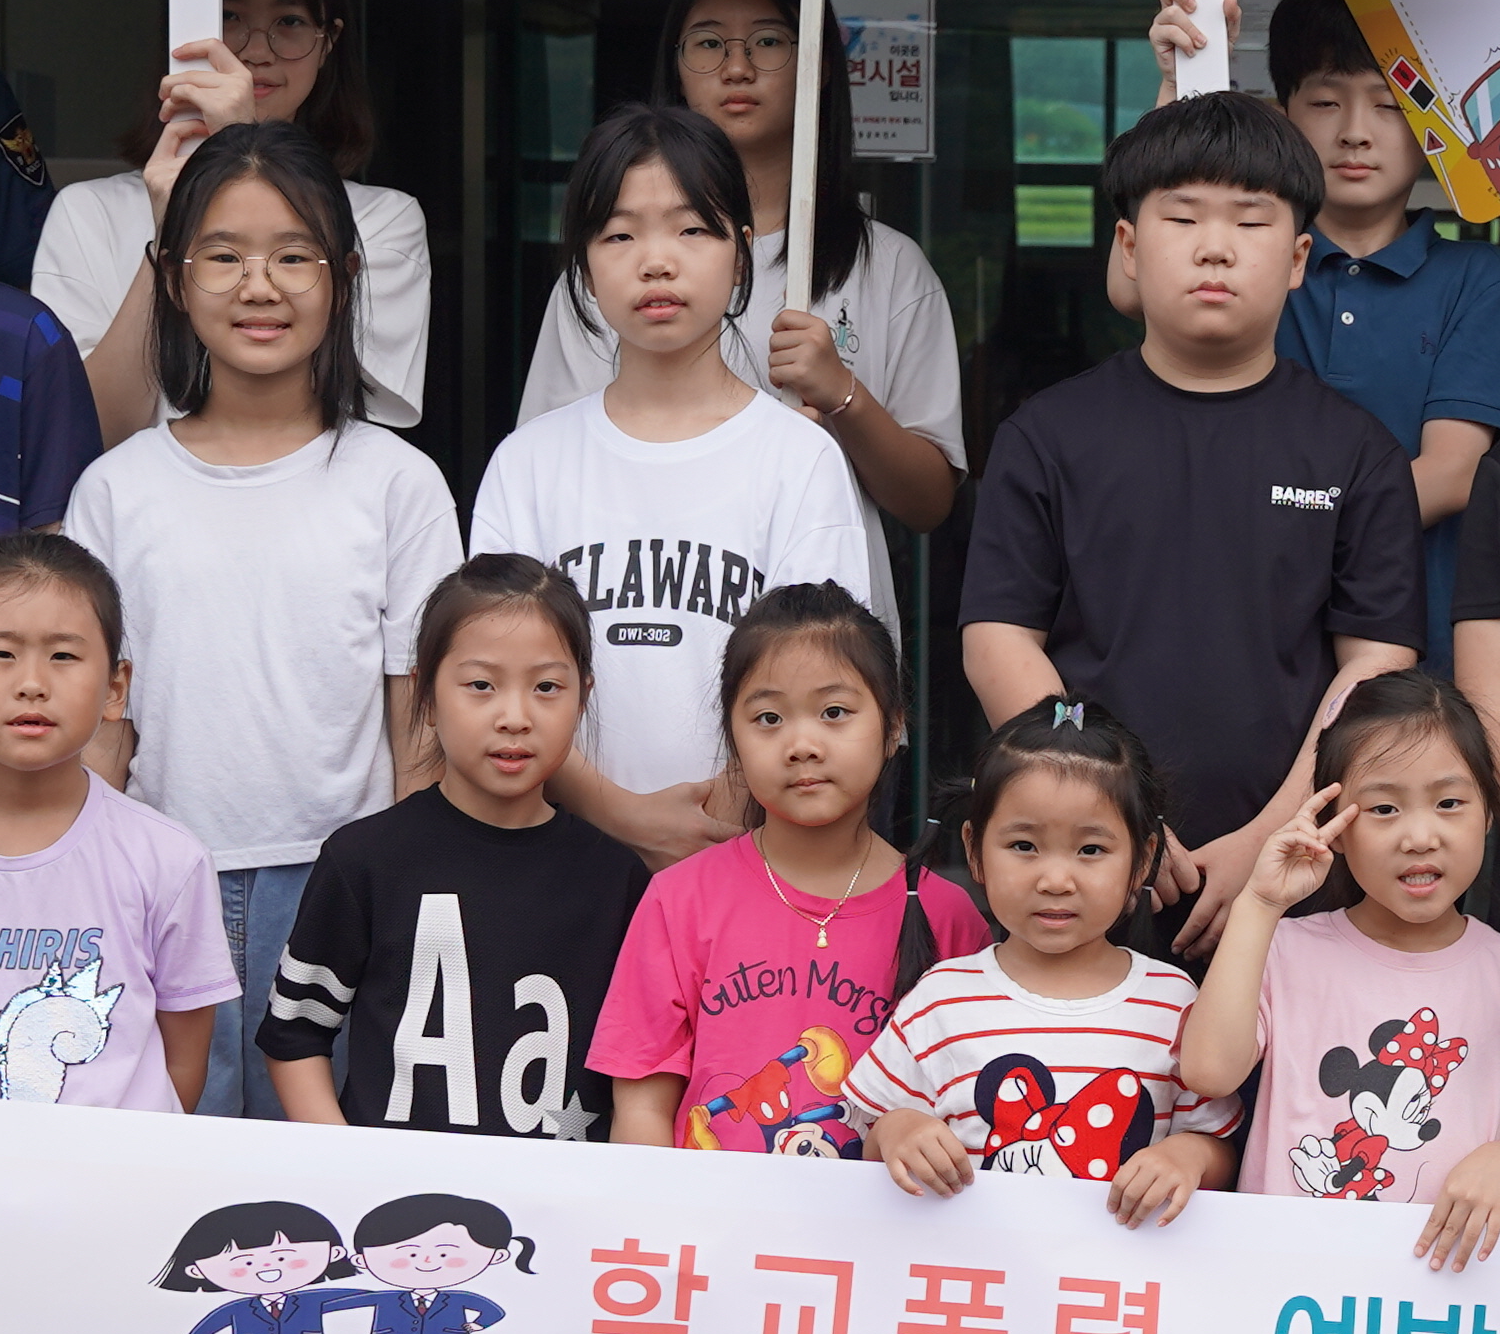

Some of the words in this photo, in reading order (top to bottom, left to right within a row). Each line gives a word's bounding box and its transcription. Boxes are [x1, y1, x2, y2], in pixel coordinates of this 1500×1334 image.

[847, 59, 921, 88] 연시설
[1271, 485, 1334, 507] BARREL
[700, 960, 798, 1016] Guten
